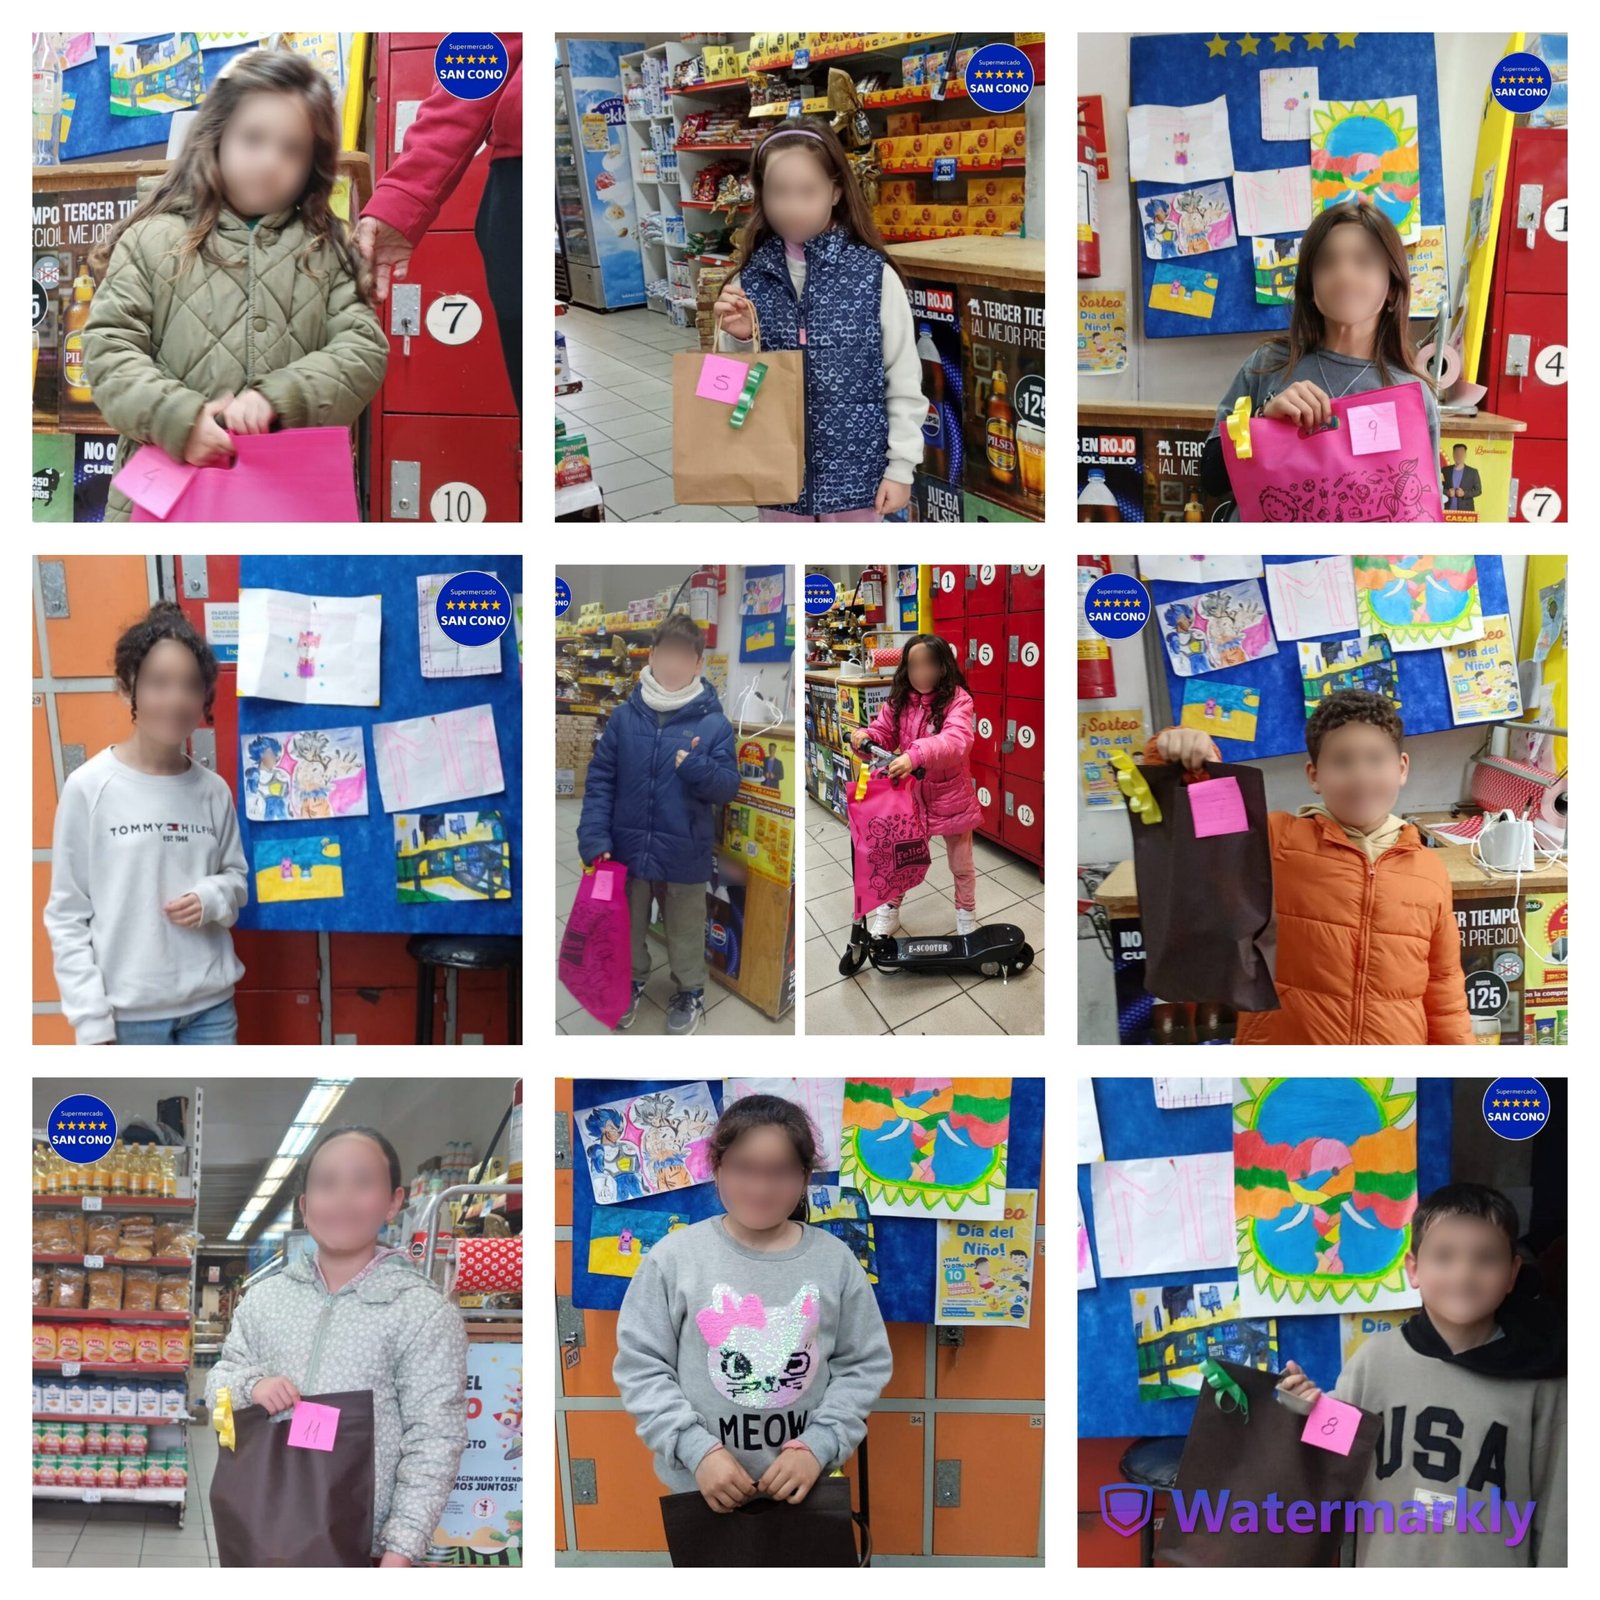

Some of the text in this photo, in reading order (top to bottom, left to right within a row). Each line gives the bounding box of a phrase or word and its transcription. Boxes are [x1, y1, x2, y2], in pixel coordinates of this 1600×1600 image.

[63, 201, 114, 222] TERCER
[914, 290, 926, 307] EN
[927, 291, 953, 310] ROJO
[441, 302, 468, 335] 7
[983, 300, 1021, 324] TERCER
[988, 322, 1021, 346] MEJOR
[1545, 351, 1565, 378] 4
[84, 442, 104, 460] NO
[987, 435, 1016, 452] PILSEN
[1082, 437, 1099, 453] EN
[1100, 438, 1136, 454] ROJO
[443, 490, 472, 523] 10
[927, 485, 960, 515] JUEGA
[1532, 493, 1552, 517] 7
[944, 575, 953, 588] 1
[983, 565, 993, 581] 2
[981, 646, 991, 660] 5
[1024, 646, 1036, 662] 6
[1481, 643, 1499, 656] del
[980, 720, 990, 735] 8
[1021, 728, 1033, 745] 9
[979, 790, 990, 805] 11
[1020, 807, 1032, 824] 12
[110, 823, 164, 837] TOMMY
[1469, 908, 1520, 928] TIEMPO
[1119, 931, 1143, 948] NO
[1469, 927, 1519, 947] PRECIO!
[908, 943, 949, 954] E-SCOOTER
[1467, 986, 1501, 1010] 125
[957, 1223, 1014, 1239] Día del
[963, 1241, 1006, 1257] Niño!
[948, 1270, 963, 1280] 10
[910, 1415, 922, 1424] 34
[1031, 1417, 1042, 1426] 35
[1320, 1416, 1339, 1436] 8
[718, 1409, 808, 1451] MEOW
[1375, 1405, 1508, 1500] USA
[475, 1482, 518, 1492] JUNTOS!
